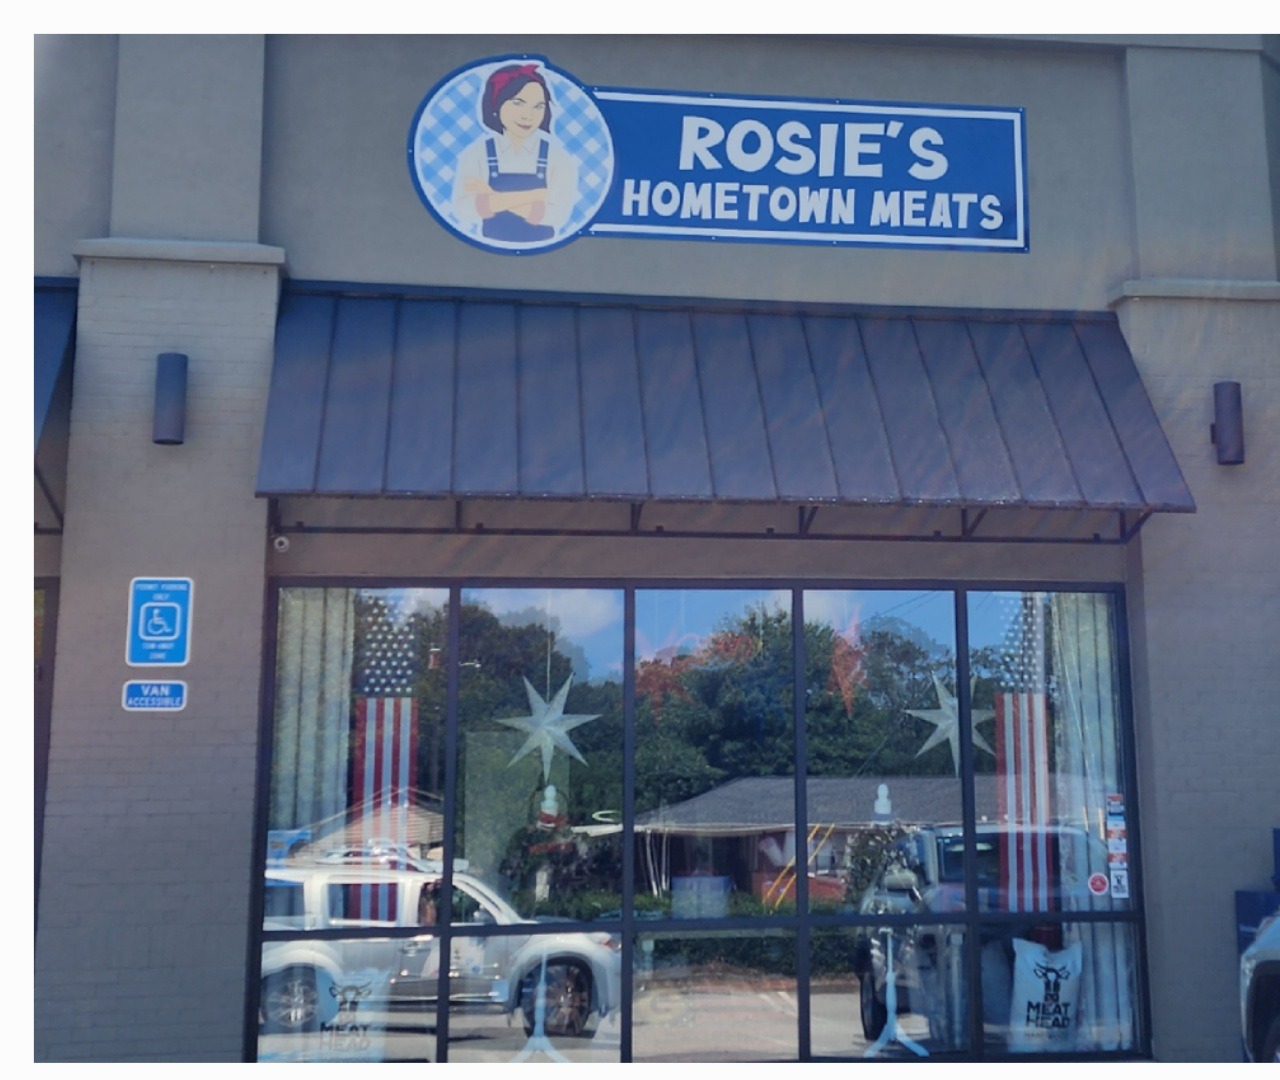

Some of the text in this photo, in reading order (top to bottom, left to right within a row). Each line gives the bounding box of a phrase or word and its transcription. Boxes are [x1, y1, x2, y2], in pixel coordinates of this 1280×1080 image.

[678, 115, 949, 182] ROSIE'S
[621, 179, 1004, 232] HOMETOWN MEATS
[140, 684, 169, 697] VAN
[1026, 1000, 1071, 1016] MEAT
[1025, 1015, 1070, 1029] HEAD
